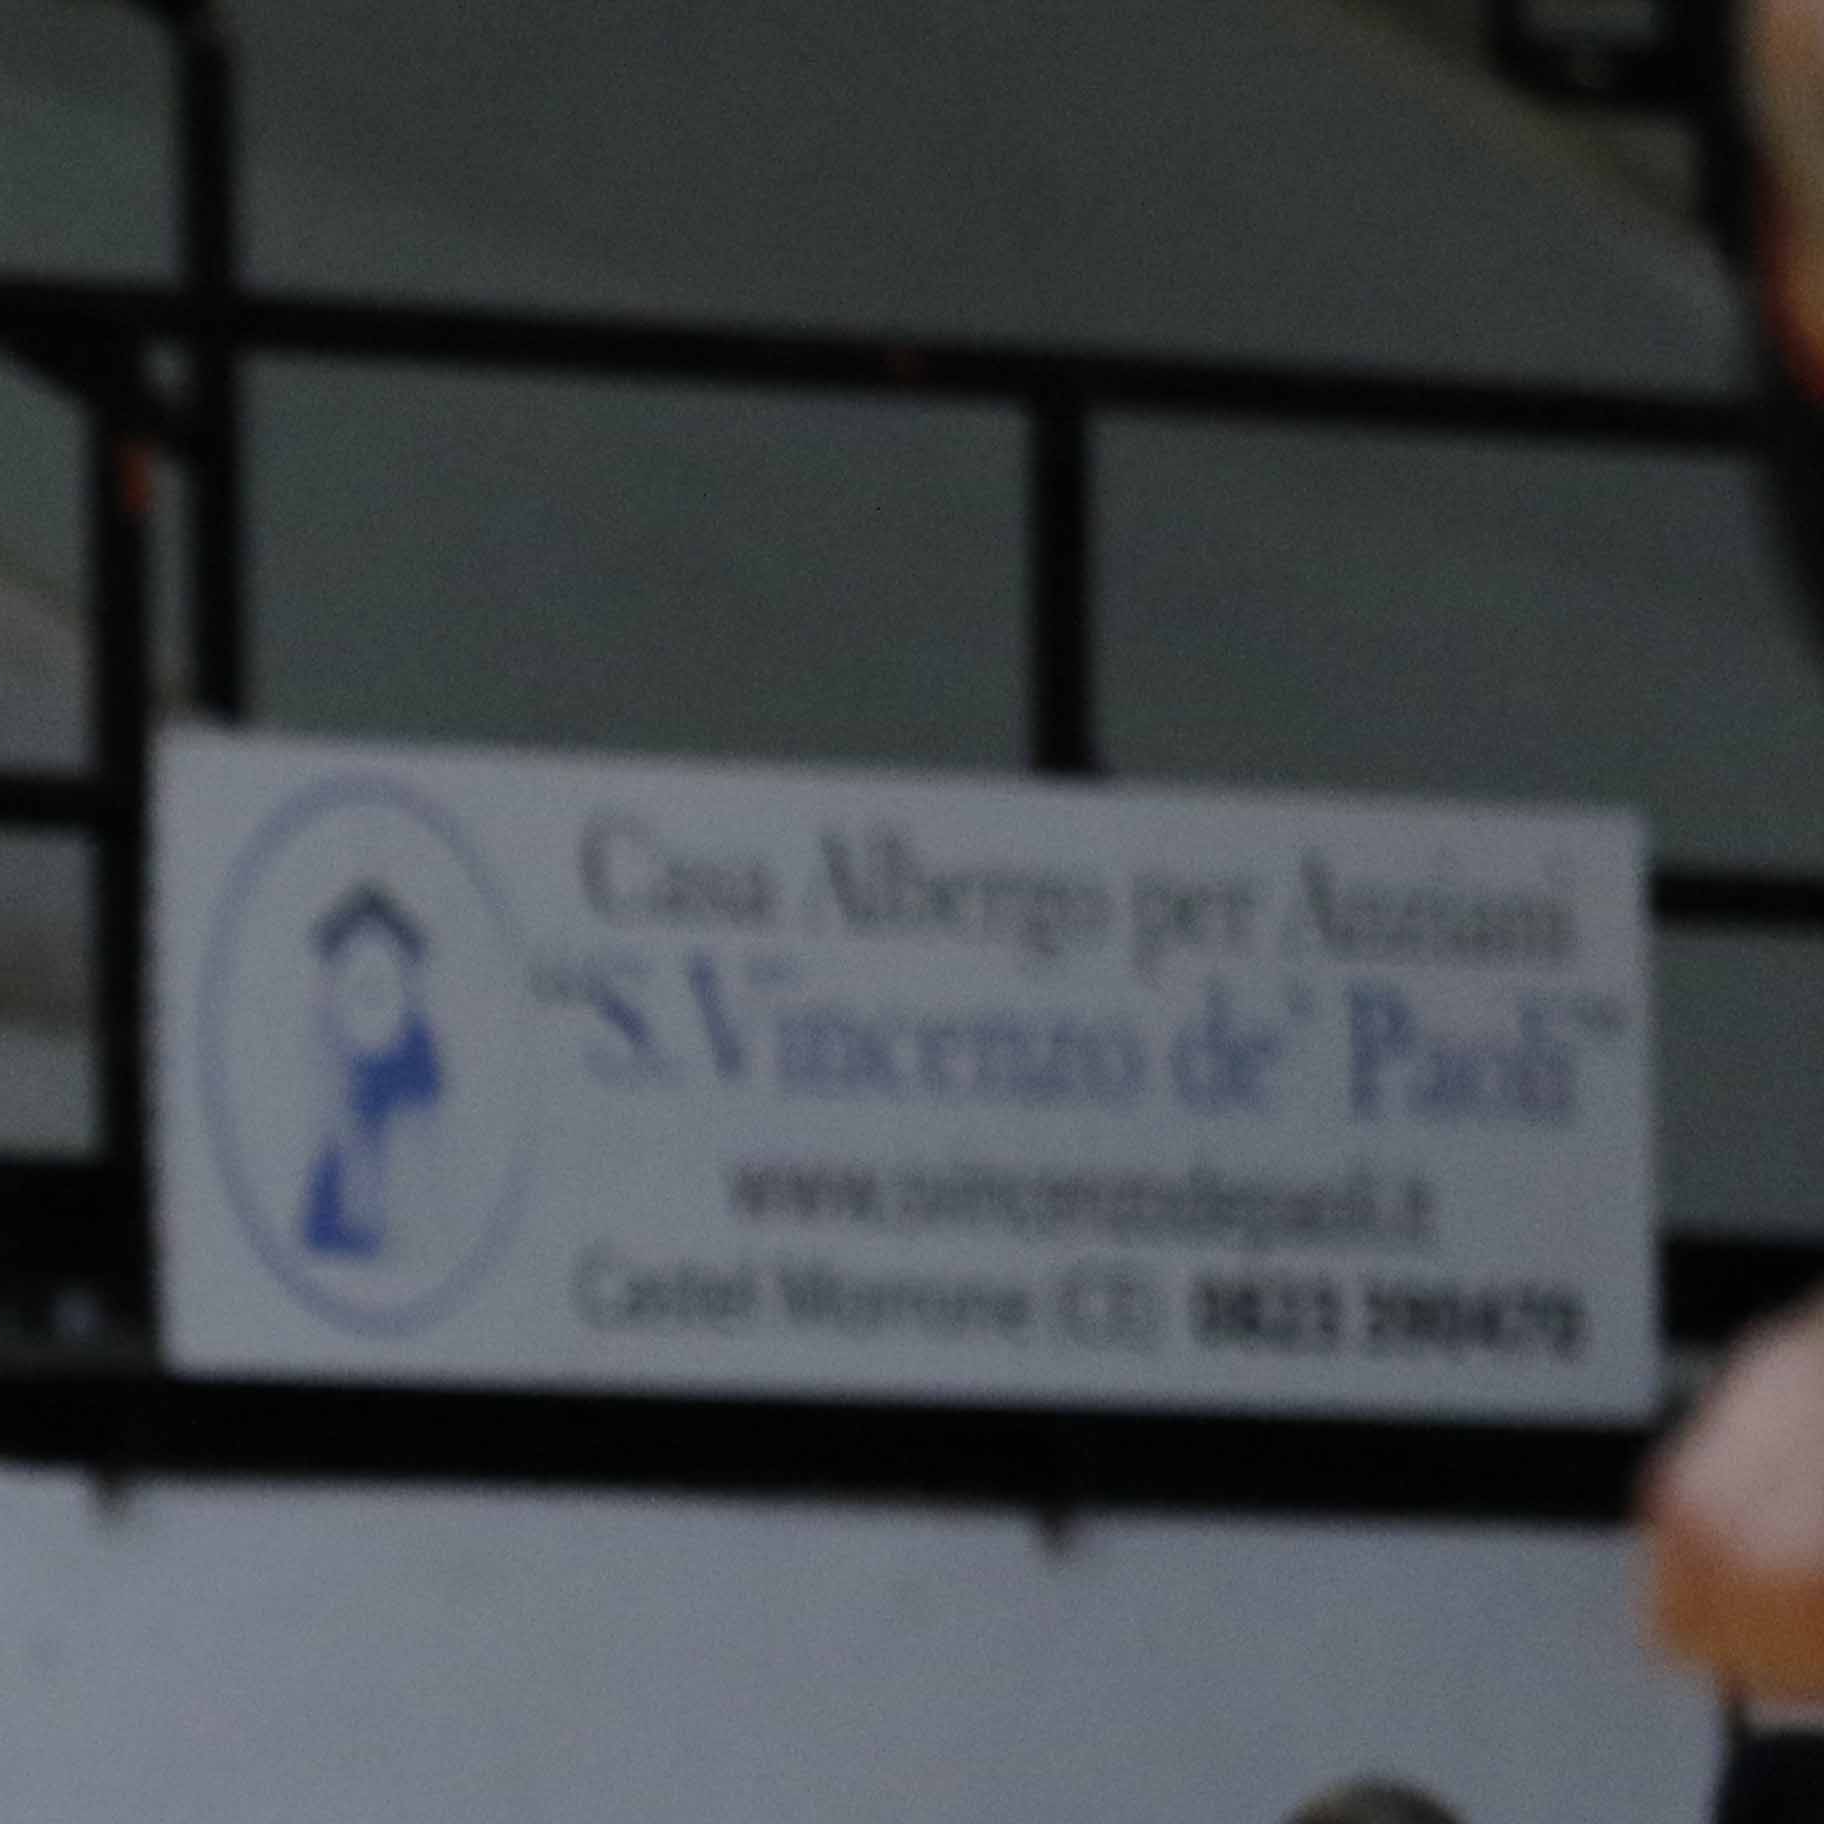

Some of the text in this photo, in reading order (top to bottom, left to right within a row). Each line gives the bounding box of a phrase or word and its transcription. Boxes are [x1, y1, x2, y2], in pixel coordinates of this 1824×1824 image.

[580, 812, 777, 930] Casa
[807, 822, 1114, 966] Albergo
[1131, 862, 1263, 976] per
